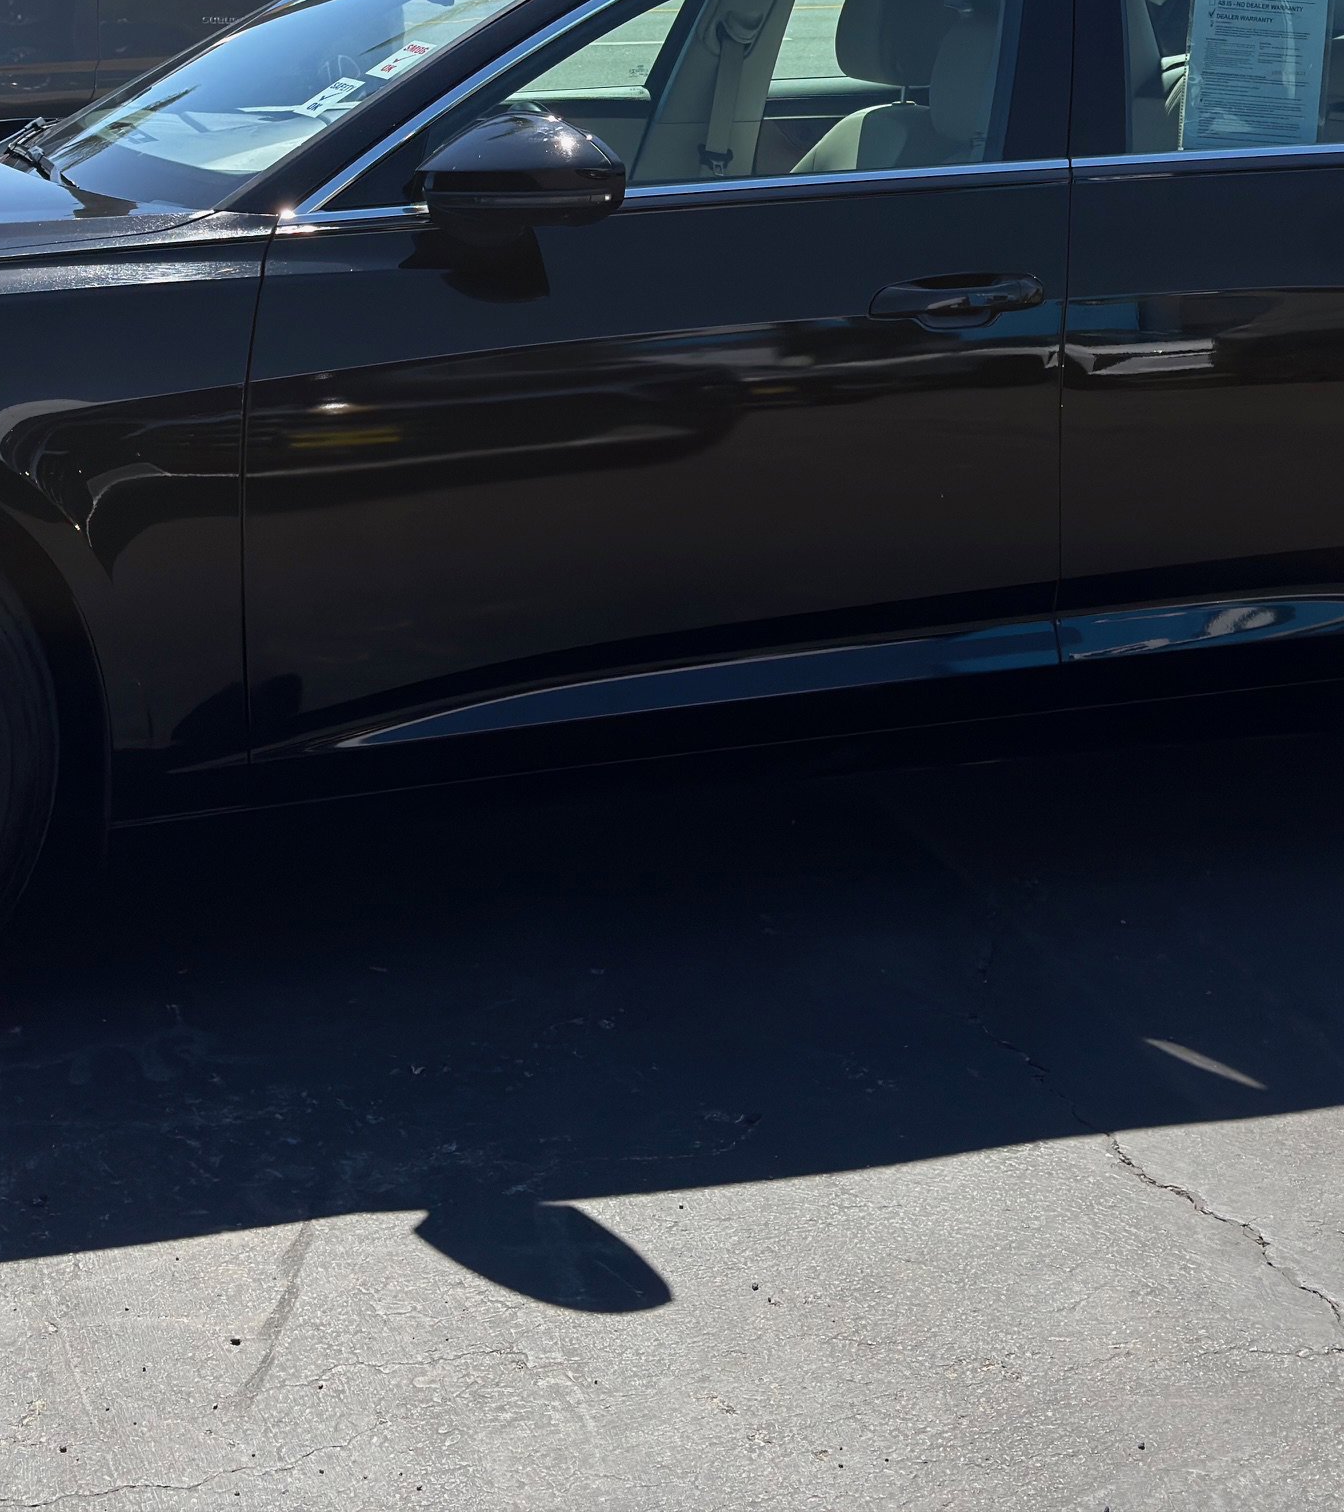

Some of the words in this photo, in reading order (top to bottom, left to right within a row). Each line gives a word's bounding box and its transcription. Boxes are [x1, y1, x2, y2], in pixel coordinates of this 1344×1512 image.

[1271, 4, 1304, 12] WARRANTY
[1216, 13, 1239, 21] DEALER
[403, 44, 430, 55] SMOG
[307, 102, 324, 112] OK
